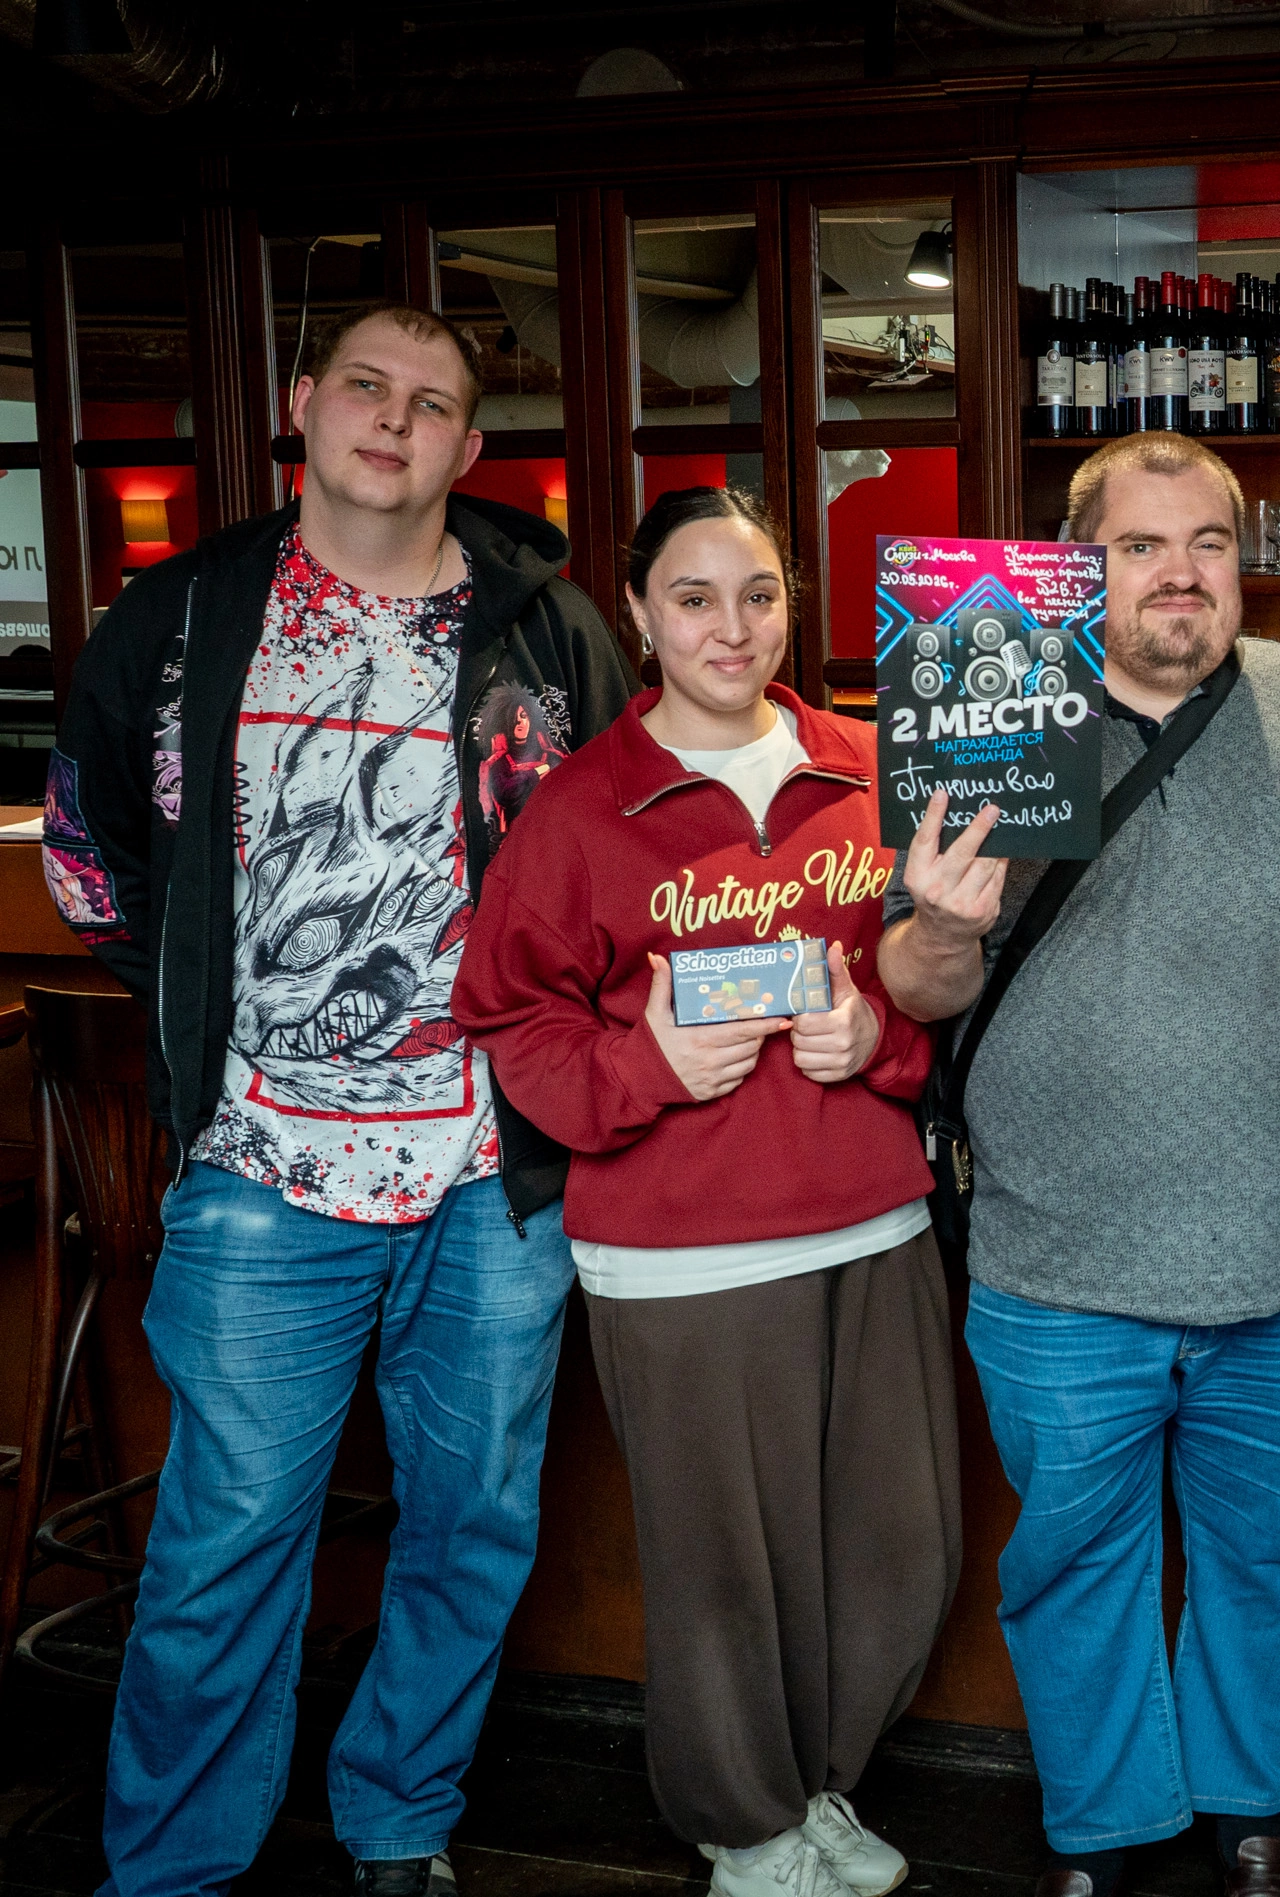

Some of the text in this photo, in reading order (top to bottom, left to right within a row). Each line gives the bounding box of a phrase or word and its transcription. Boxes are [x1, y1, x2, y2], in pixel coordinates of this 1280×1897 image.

[884, 546, 922, 562] Смузи
[891, 692, 1088, 742] 2 МЕСТО
[934, 731, 1045, 753] НАГРАЖДАЕТСЯ
[953, 747, 1025, 766] КОМАНДА
[650, 868, 804, 937] Vintage
[675, 946, 778, 973] Schogetten
